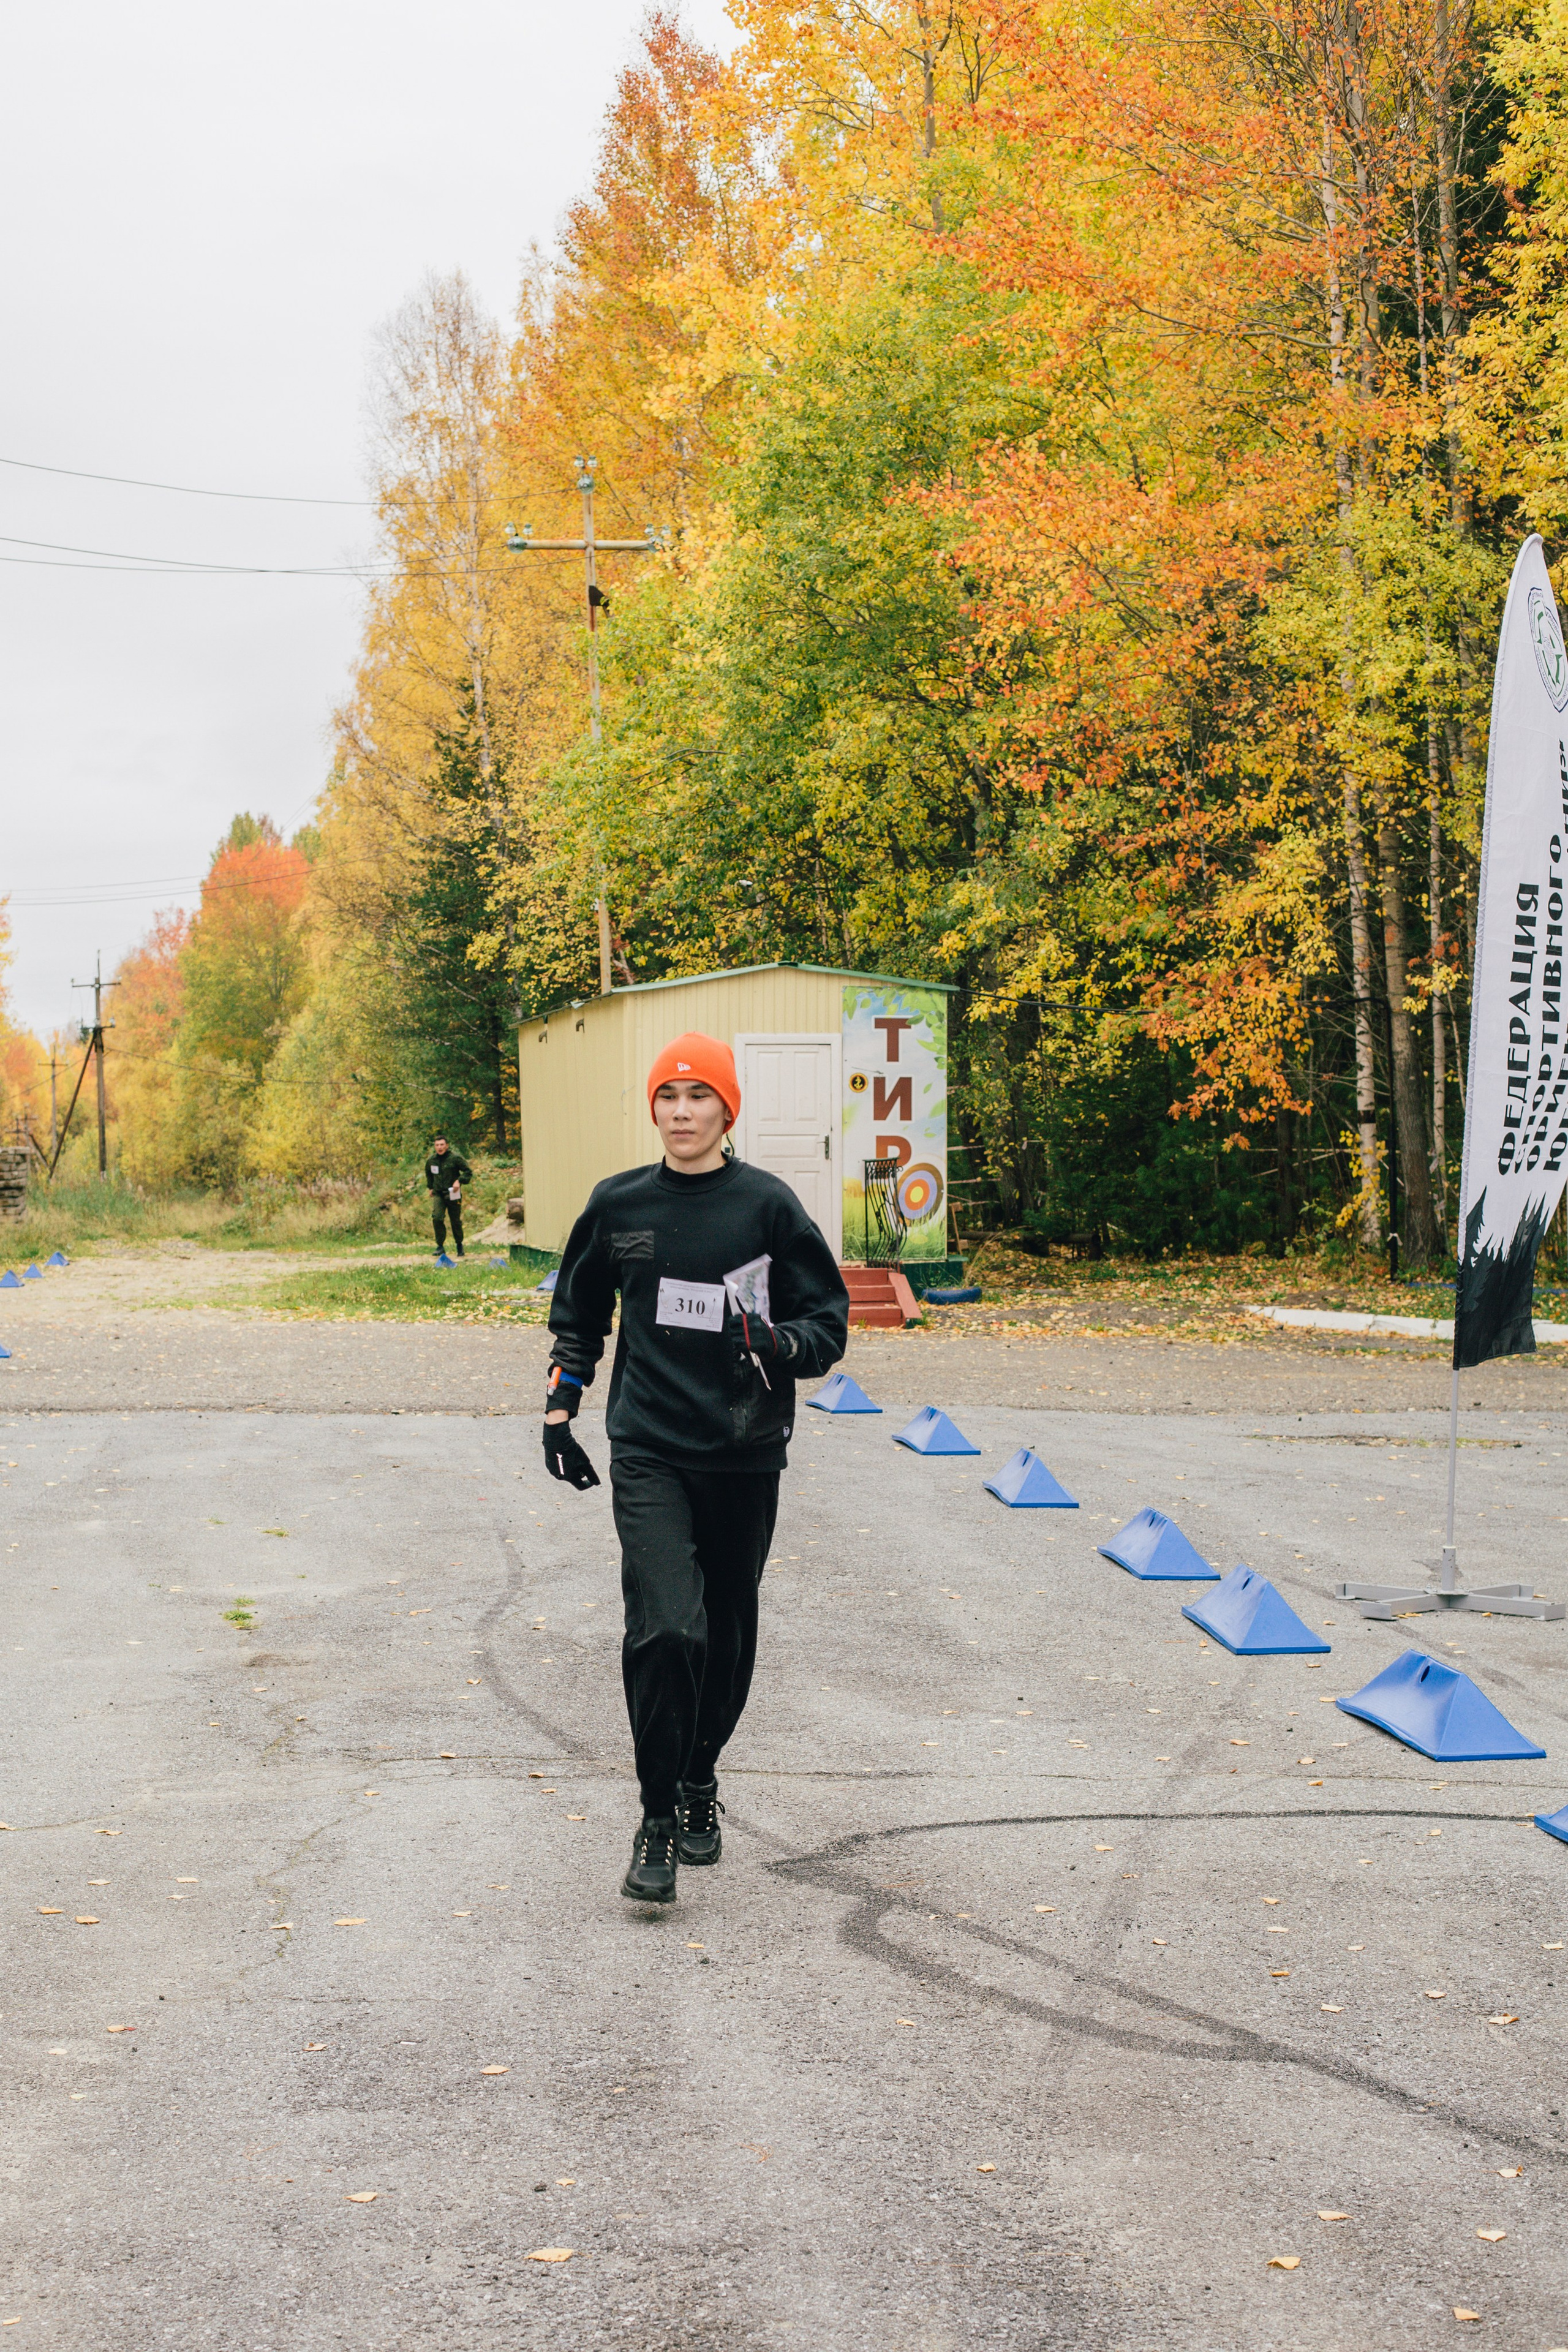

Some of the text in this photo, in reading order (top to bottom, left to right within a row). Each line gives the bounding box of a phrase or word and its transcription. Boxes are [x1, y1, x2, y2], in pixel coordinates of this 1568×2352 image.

[873, 1018, 912, 1179] ТИР
[1498, 883, 1539, 1175] ФЕДЕРАЦИЯ
[1515, 835, 1563, 1174] СПОРТИВНОГО
[675, 1298, 706, 1315] 310
